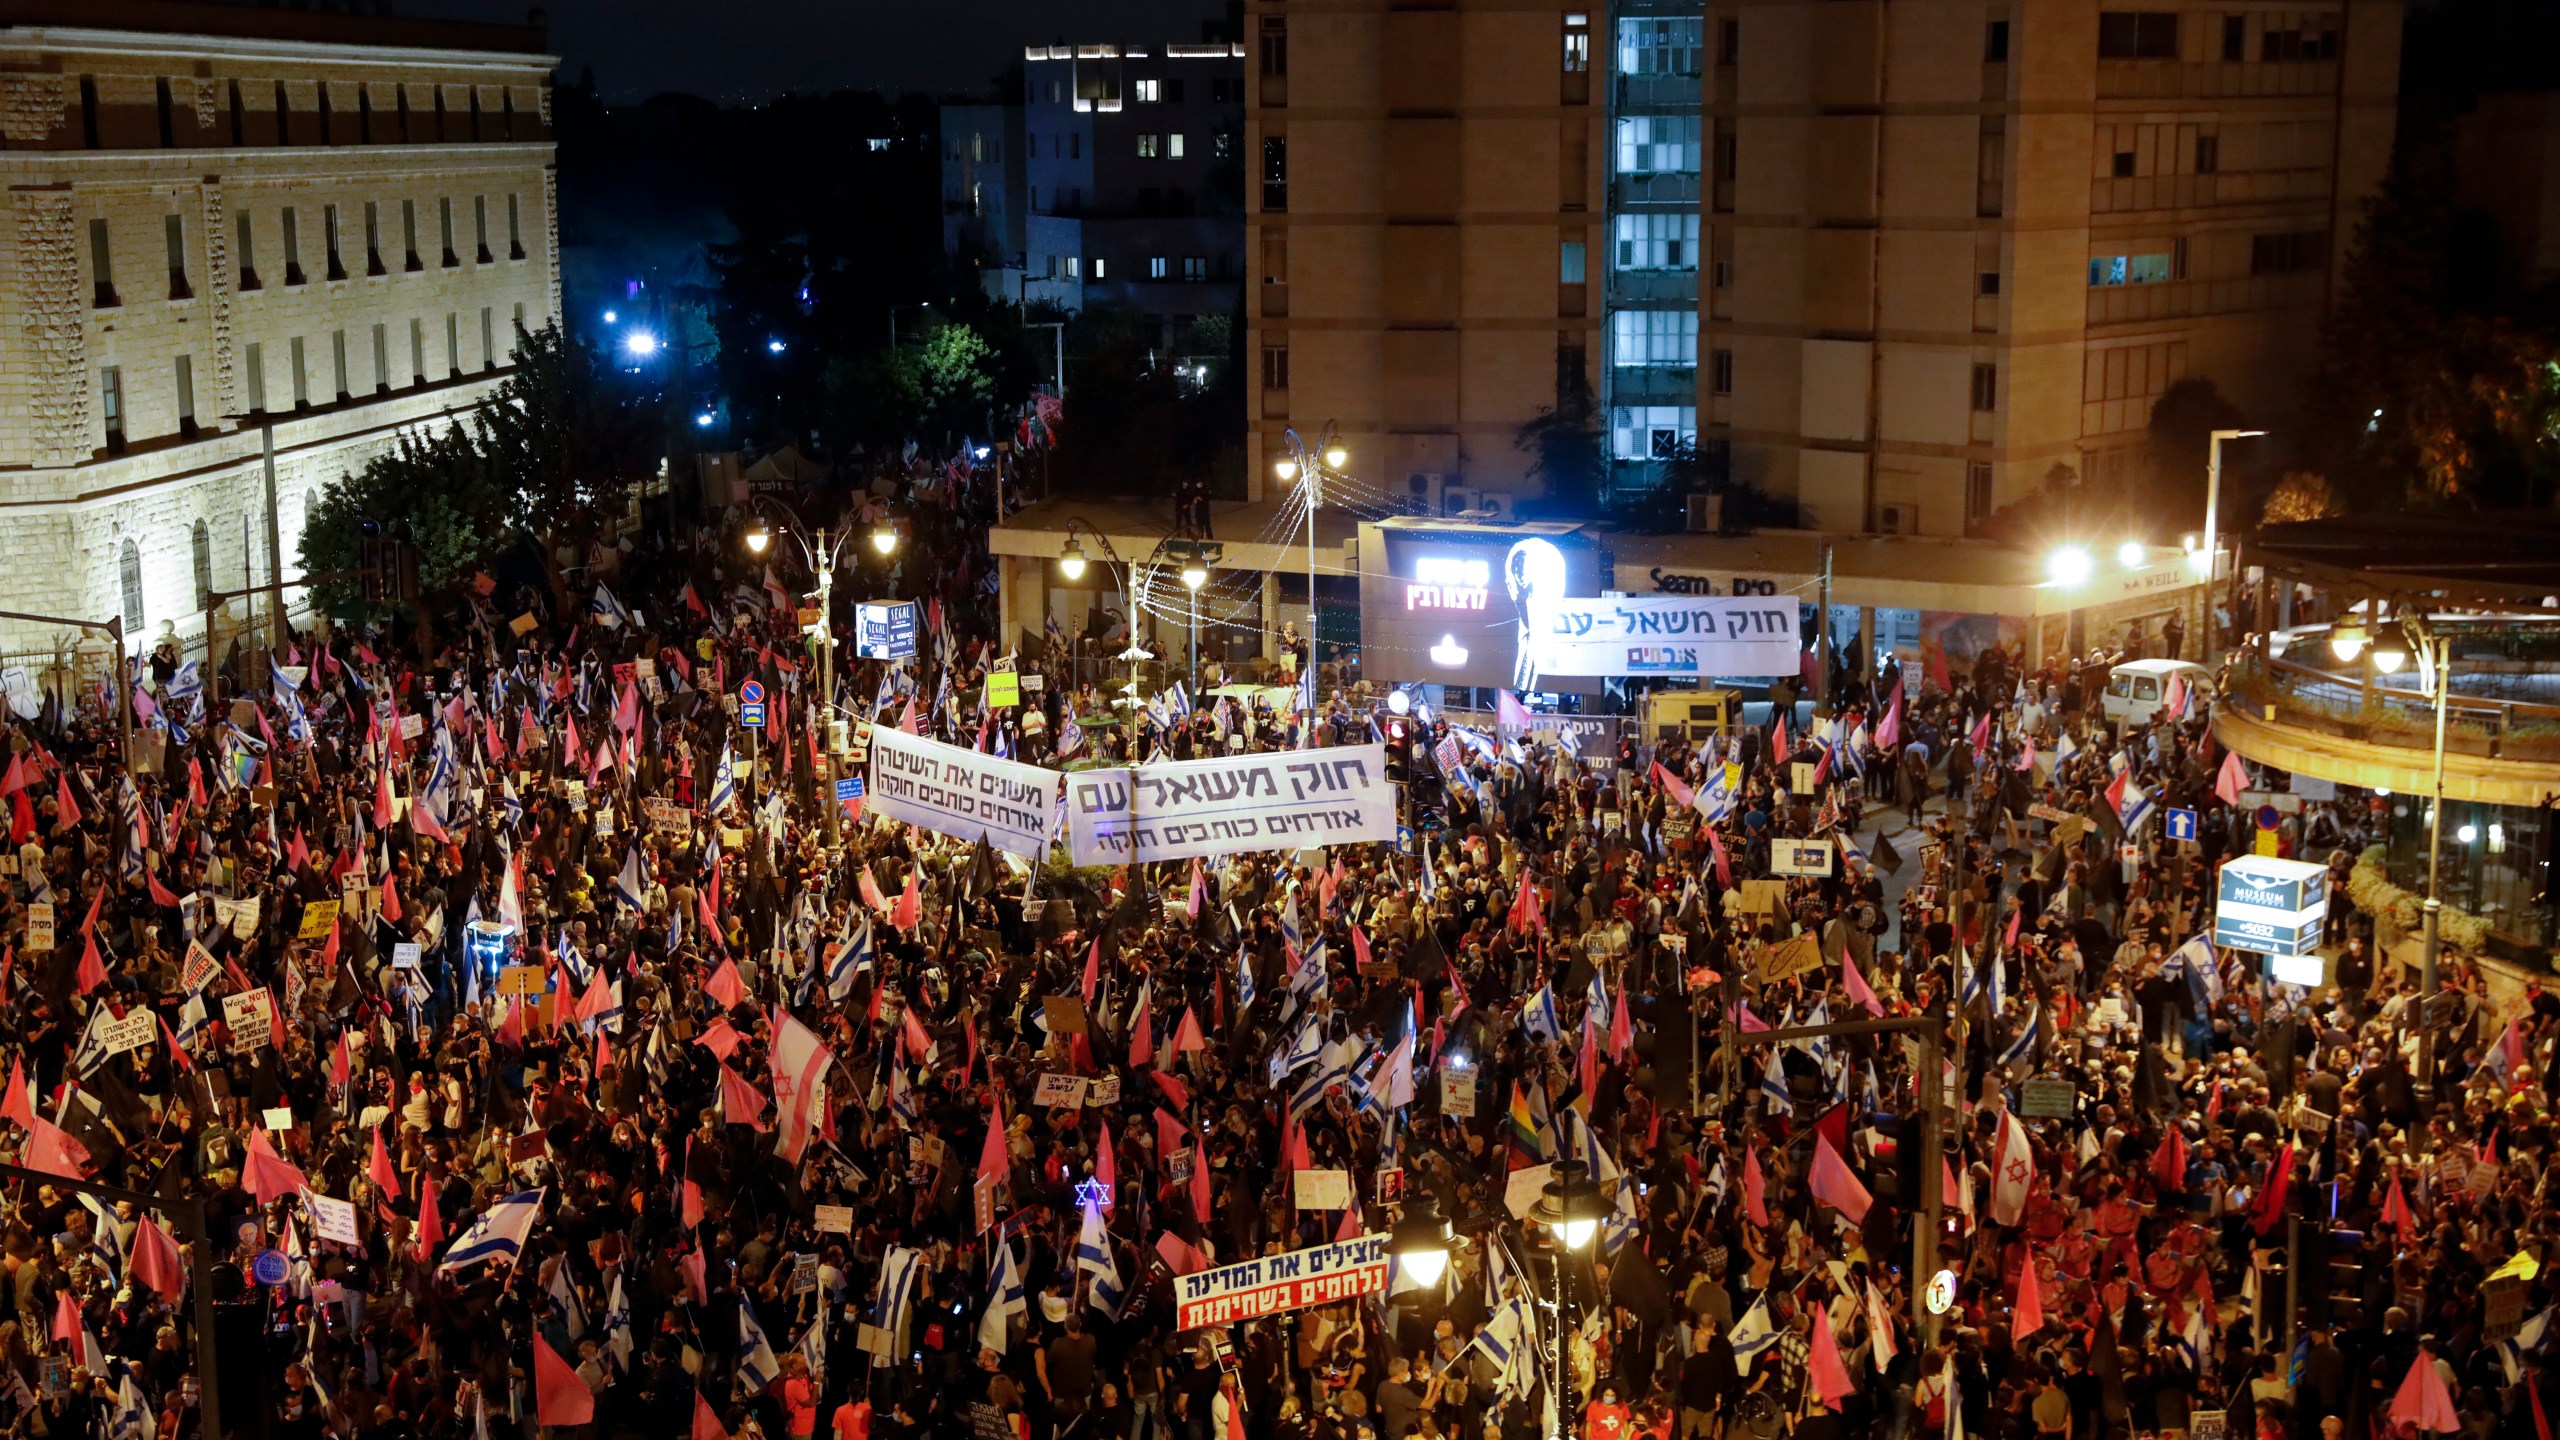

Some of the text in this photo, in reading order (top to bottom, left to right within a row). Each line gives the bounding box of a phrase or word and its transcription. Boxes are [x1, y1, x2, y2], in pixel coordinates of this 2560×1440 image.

[1650, 568, 1710, 595] Seam
[1733, 578, 1776, 597] סים
[2145, 571, 2181, 588] WEILL
[1407, 584, 1439, 611] רבין
[891, 606, 911, 621] SEGAL
[868, 623, 887, 635] SEGAL
[1726, 609, 1787, 639] חוק
[1574, 720, 1606, 738] גיוס
[879, 746, 1043, 810] משנים את השיטה
[1077, 757, 1370, 816] חוק משאל עם
[880, 772, 1044, 835] אזרחים כותבים חוקה
[676, 822, 689, 830] את
[1096, 807, 1365, 852] אזרחים כותבים חוקה
[2234, 887, 2284, 903] MUSEUM
[305, 909, 313, 917] IN
[31, 919, 52, 930] מסית
[300, 926, 315, 935] OUT
[249, 990, 267, 1003] NOT
[133, 1016, 146, 1025] לא
[230, 1016, 248, 1028] your
[118, 1033, 151, 1049] את פניה
[1309, 1239, 1384, 1271] מצילים
[1269, 1255, 1301, 1281] את
[1187, 1266, 1262, 1299] המדינה
[1301, 1268, 1384, 1304] נלחמים
[1188, 1287, 1292, 1327] בשחיתות
